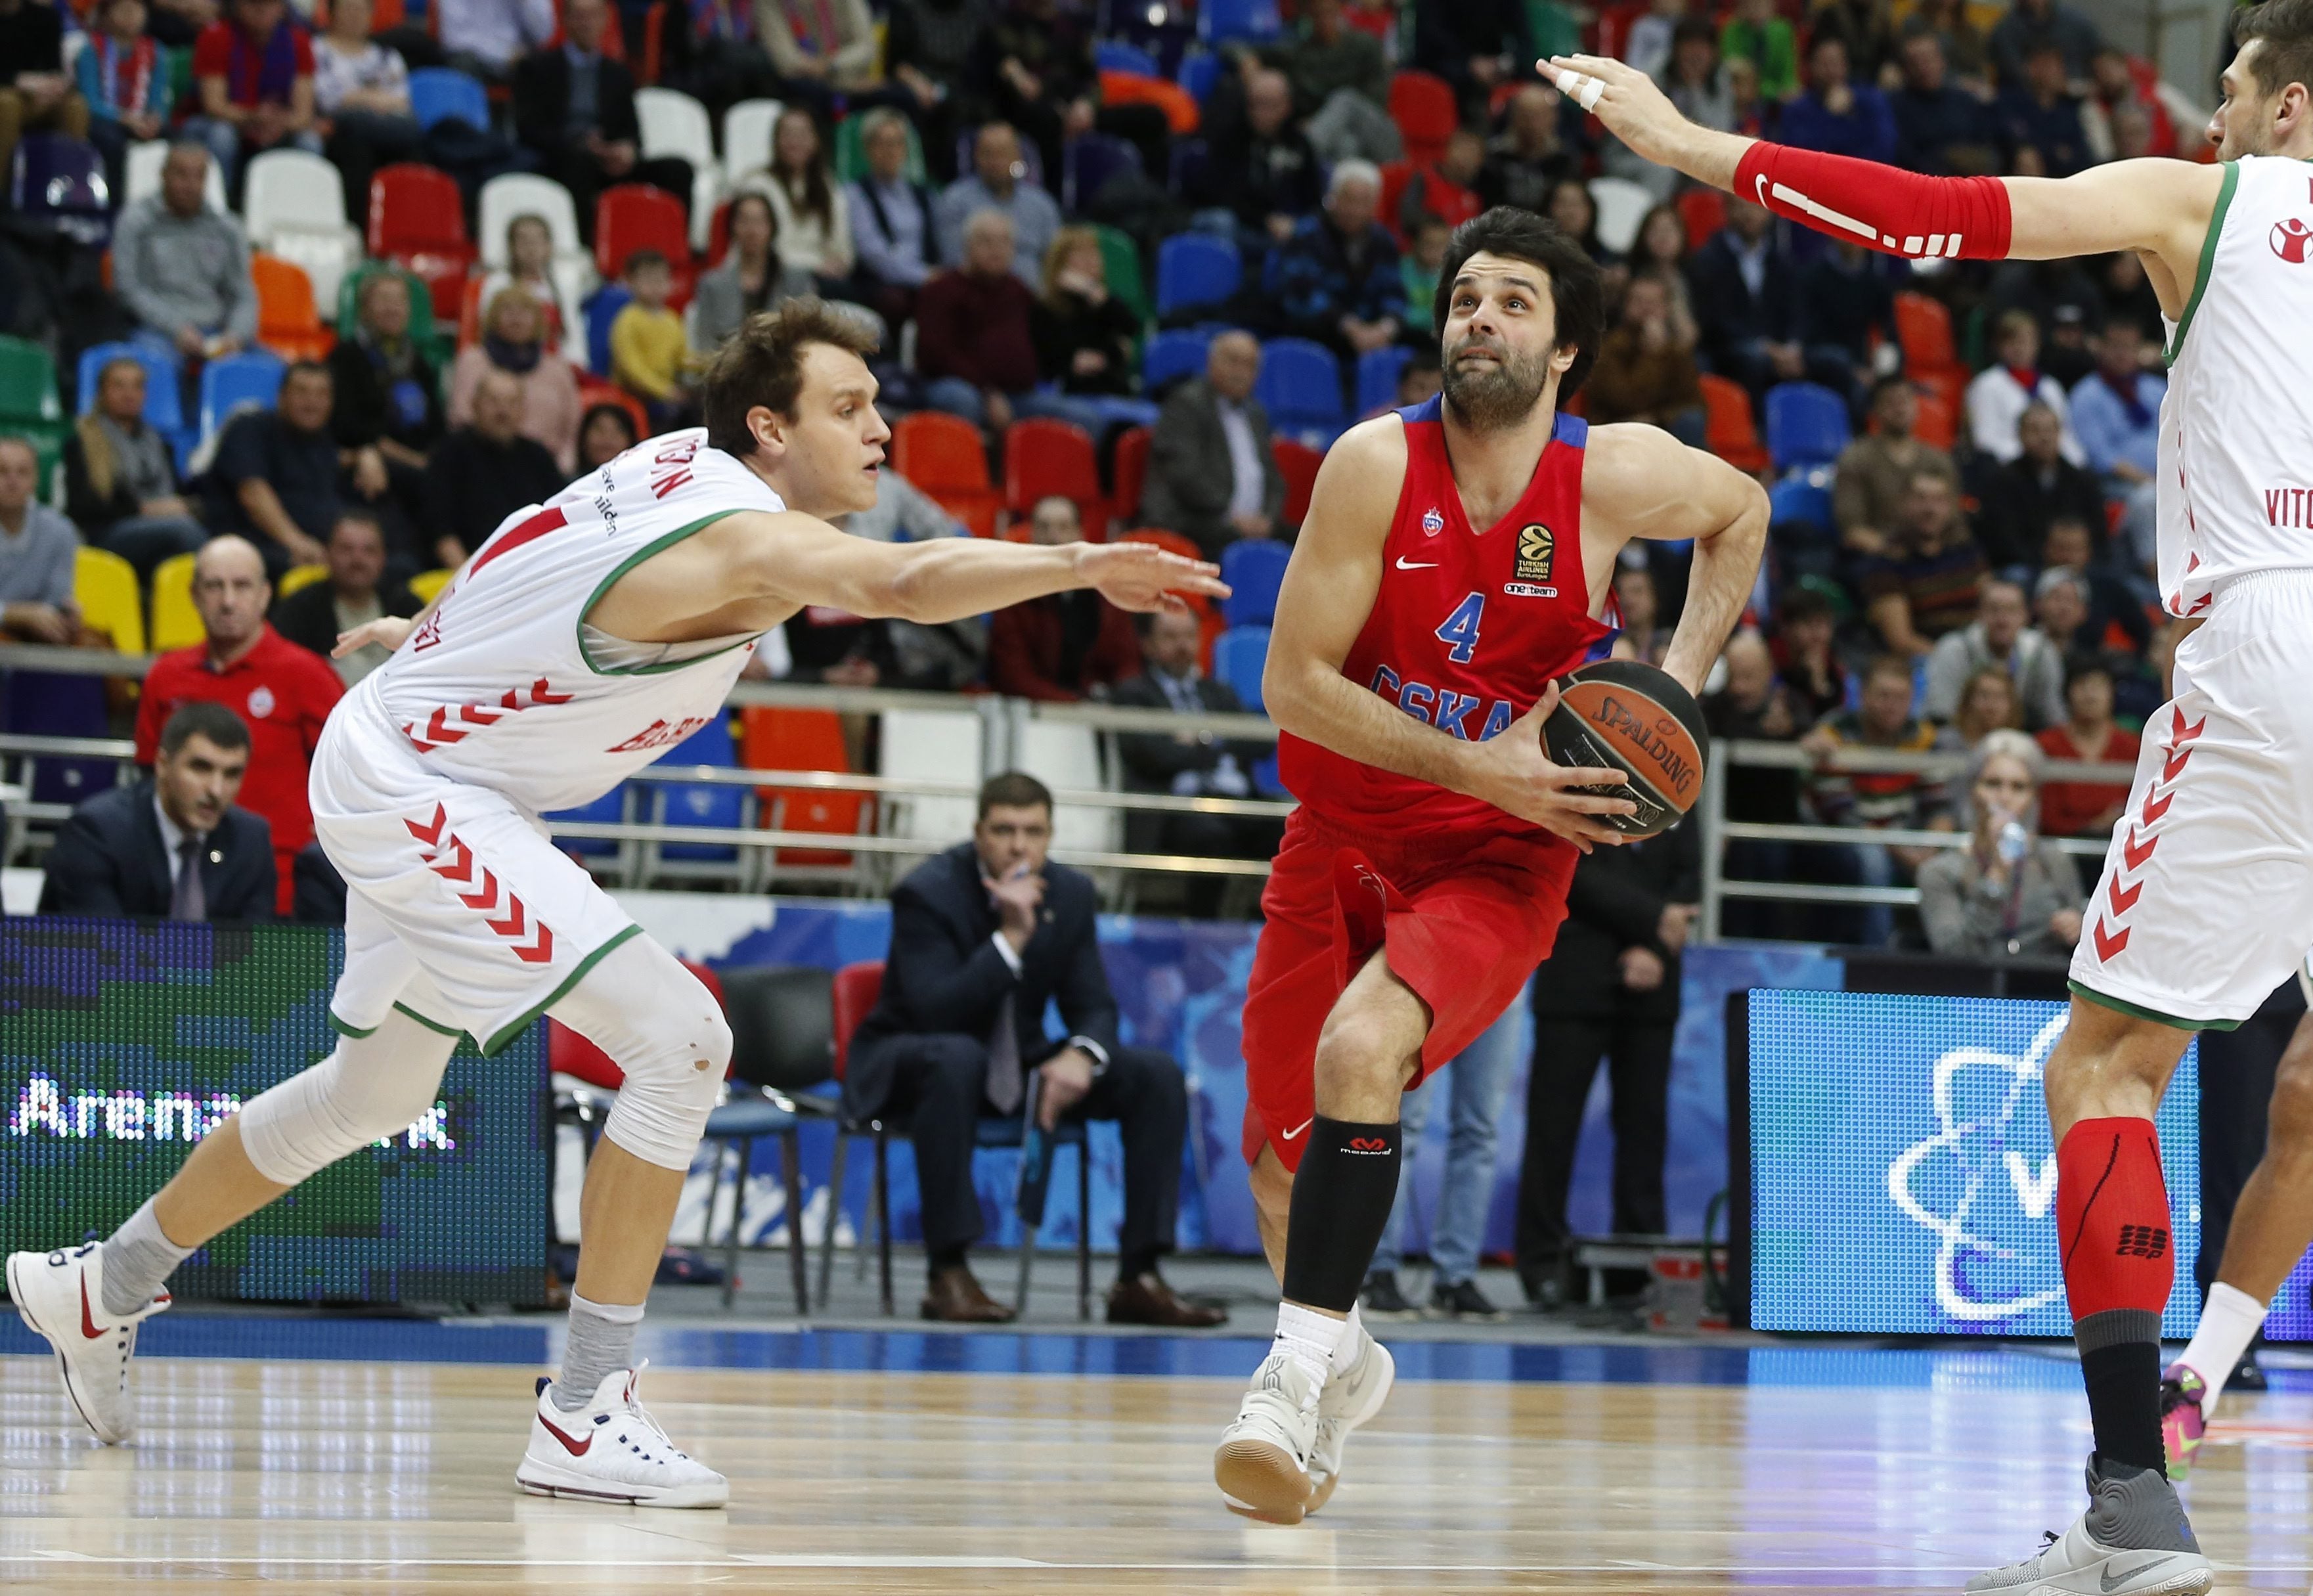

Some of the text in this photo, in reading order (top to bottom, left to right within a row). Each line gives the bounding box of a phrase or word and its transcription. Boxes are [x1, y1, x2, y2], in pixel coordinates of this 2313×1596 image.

[1518, 560, 1549, 568] TURKISH
[1434, 591, 1486, 665] 4
[1592, 696, 1696, 796] SPALDING
